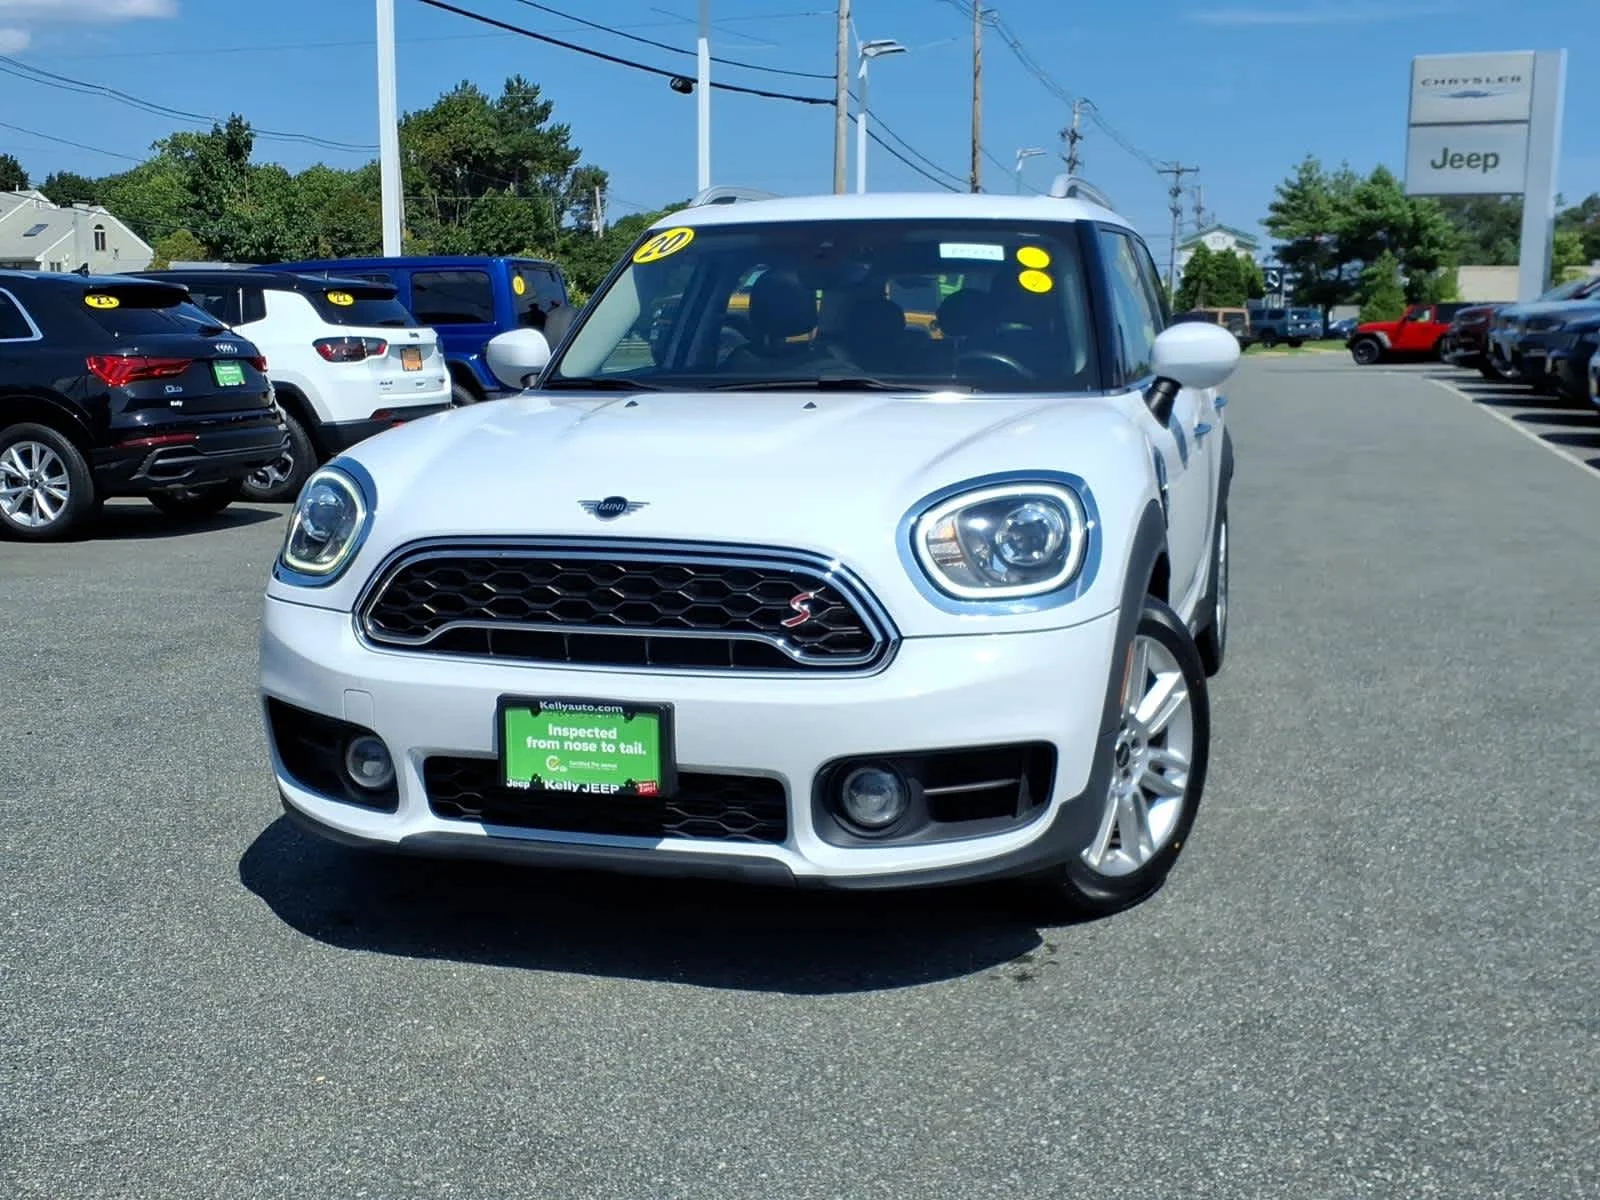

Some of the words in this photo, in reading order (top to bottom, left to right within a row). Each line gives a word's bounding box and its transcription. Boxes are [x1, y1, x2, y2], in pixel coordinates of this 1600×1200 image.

[1420, 76, 1522, 87] CHRYSLER
[1429, 147, 1500, 174] Jeep
[638, 231, 688, 259] 20
[598, 503, 625, 512] MINI
[781, 592, 814, 628] S
[539, 701, 624, 713] Kellyauto.com
[548, 723, 618, 740] Inspected
[526, 736, 560, 750] from
[564, 740, 598, 752] nose
[600, 741, 616, 753] to
[619, 742, 647, 755] tail.
[506, 778, 530, 790] Jeep
[544, 779, 580, 793] Kelly
[582, 783, 620, 794] JEEP
